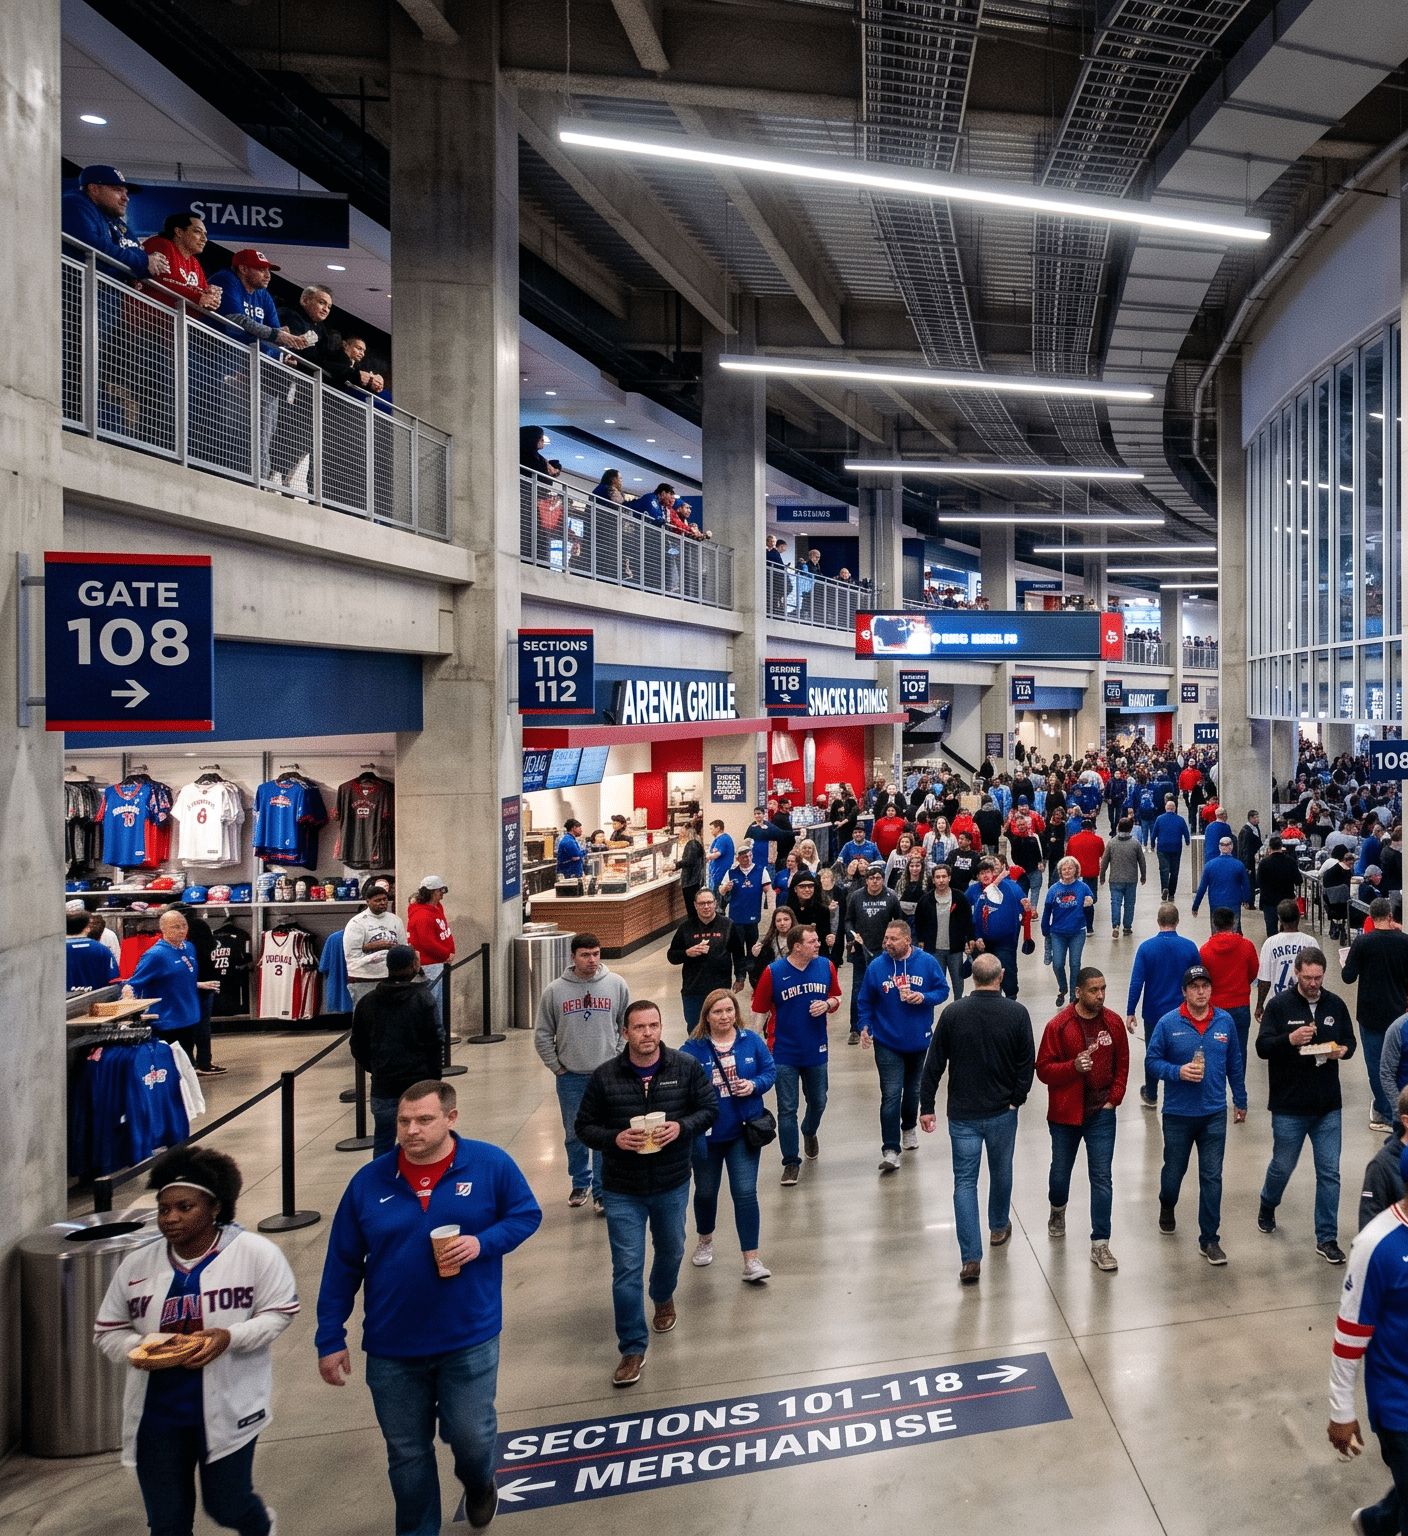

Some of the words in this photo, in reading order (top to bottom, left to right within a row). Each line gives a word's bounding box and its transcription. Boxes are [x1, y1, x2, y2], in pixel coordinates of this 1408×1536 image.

[189, 201, 284, 229] STAIRS
[77, 580, 179, 608] GATE
[67, 617, 190, 666] 108
[523, 641, 588, 651] SECTIONS
[533, 655, 578, 677] 110
[535, 680, 577, 702] 112
[771, 675, 800, 691] 118
[622, 680, 684, 725] ARENA
[686, 681, 736, 721] GRILLE
[808, 687, 847, 716] SNACKS
[502, 1402, 760, 1461] SECTIONS
[573, 1407, 958, 1494] MERCHANDISE
